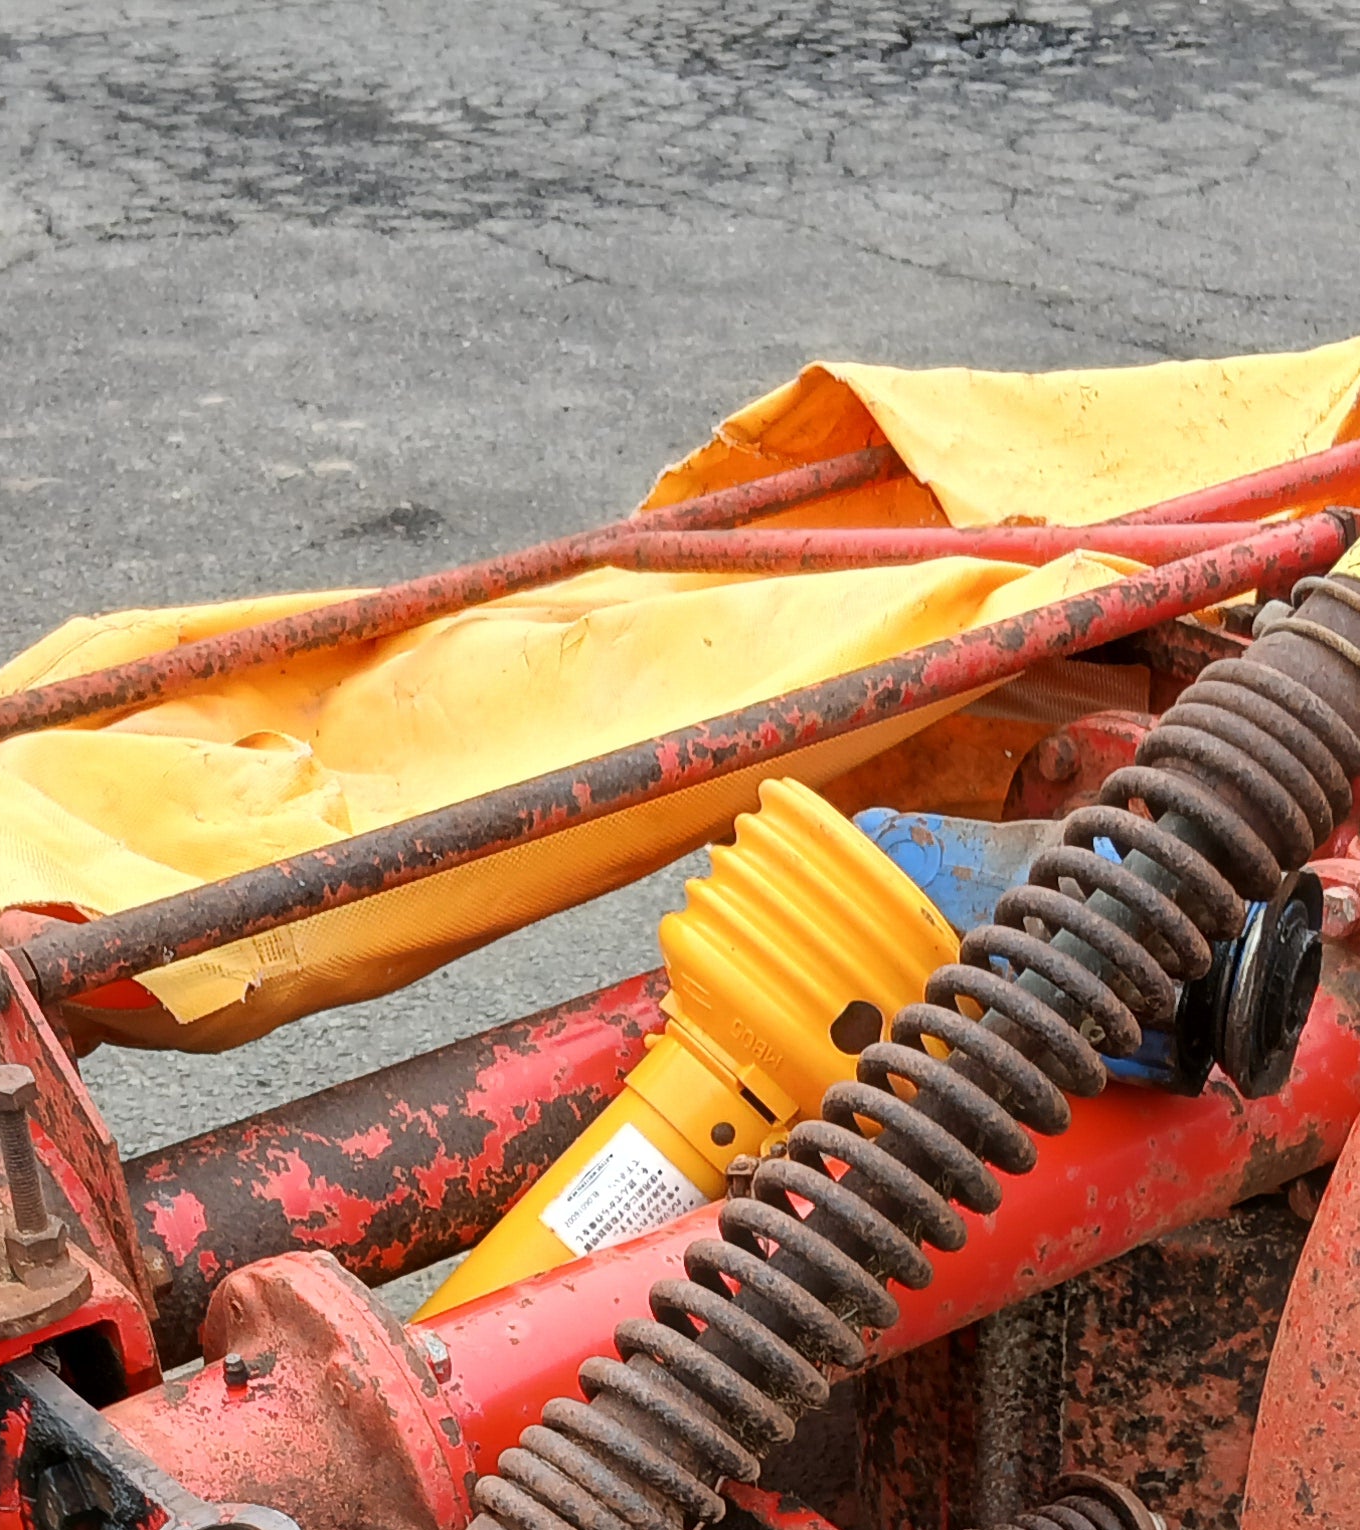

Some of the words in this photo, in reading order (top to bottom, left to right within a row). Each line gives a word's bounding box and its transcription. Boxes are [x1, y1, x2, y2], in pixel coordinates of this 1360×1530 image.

[581, 1172, 659, 1254] 使用前に必ず取扱説明書
